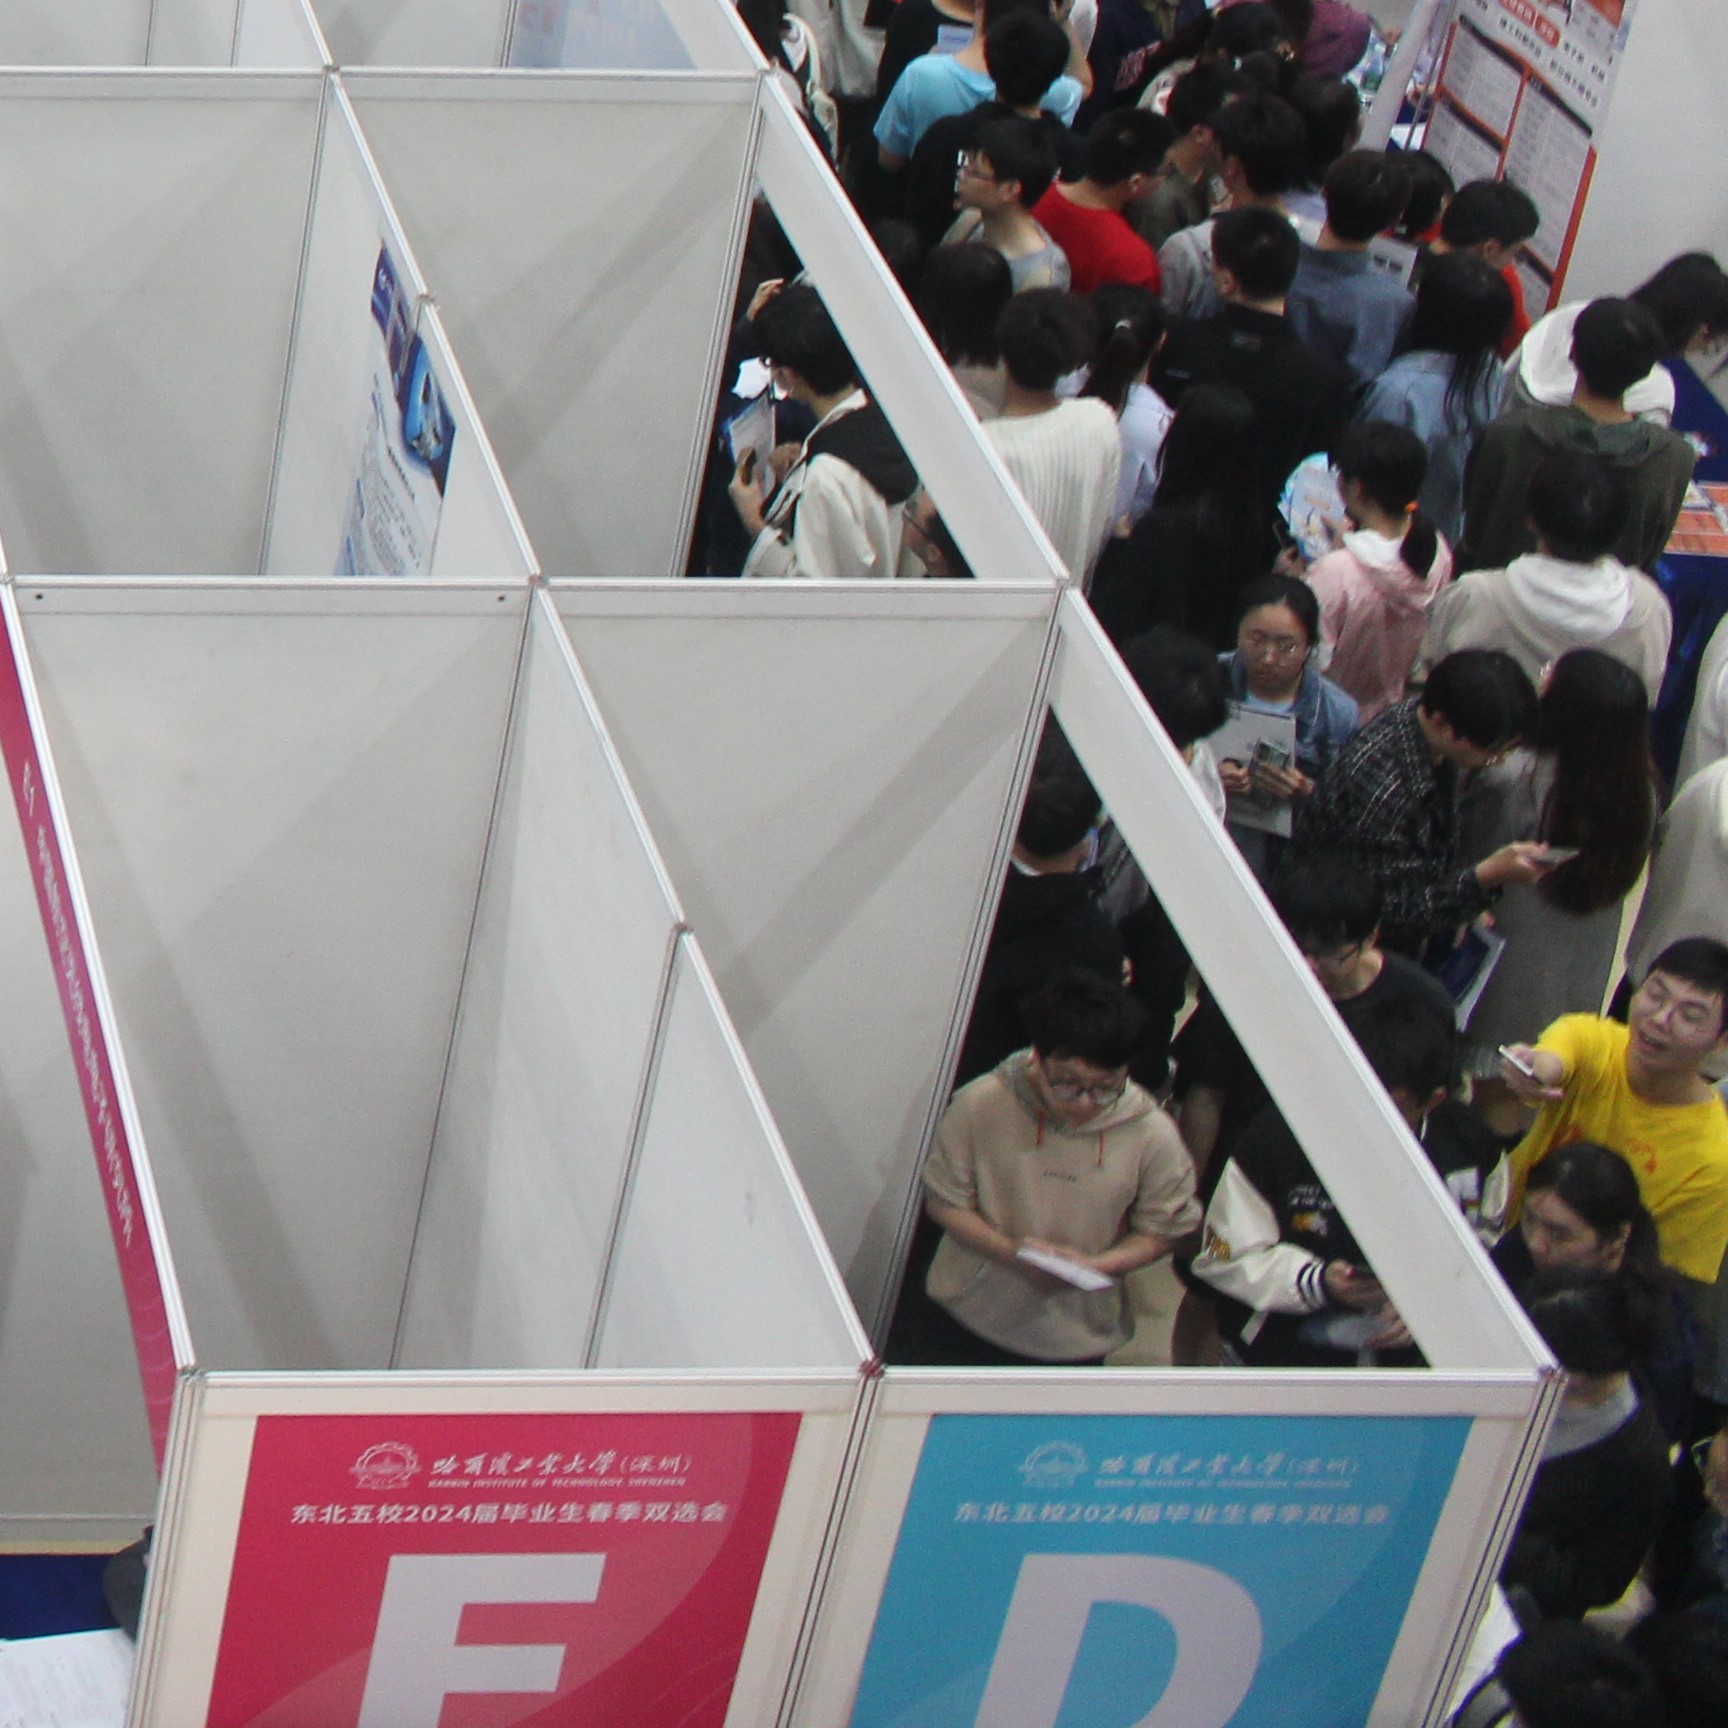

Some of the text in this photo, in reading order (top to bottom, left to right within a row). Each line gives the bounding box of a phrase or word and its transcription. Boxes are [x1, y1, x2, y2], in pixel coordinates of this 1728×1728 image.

[290, 1500, 729, 1524] 东北五校2024届毕业生春季双选会
[954, 1501, 1391, 1525] 东北五校2024届毕业生春季双选会
